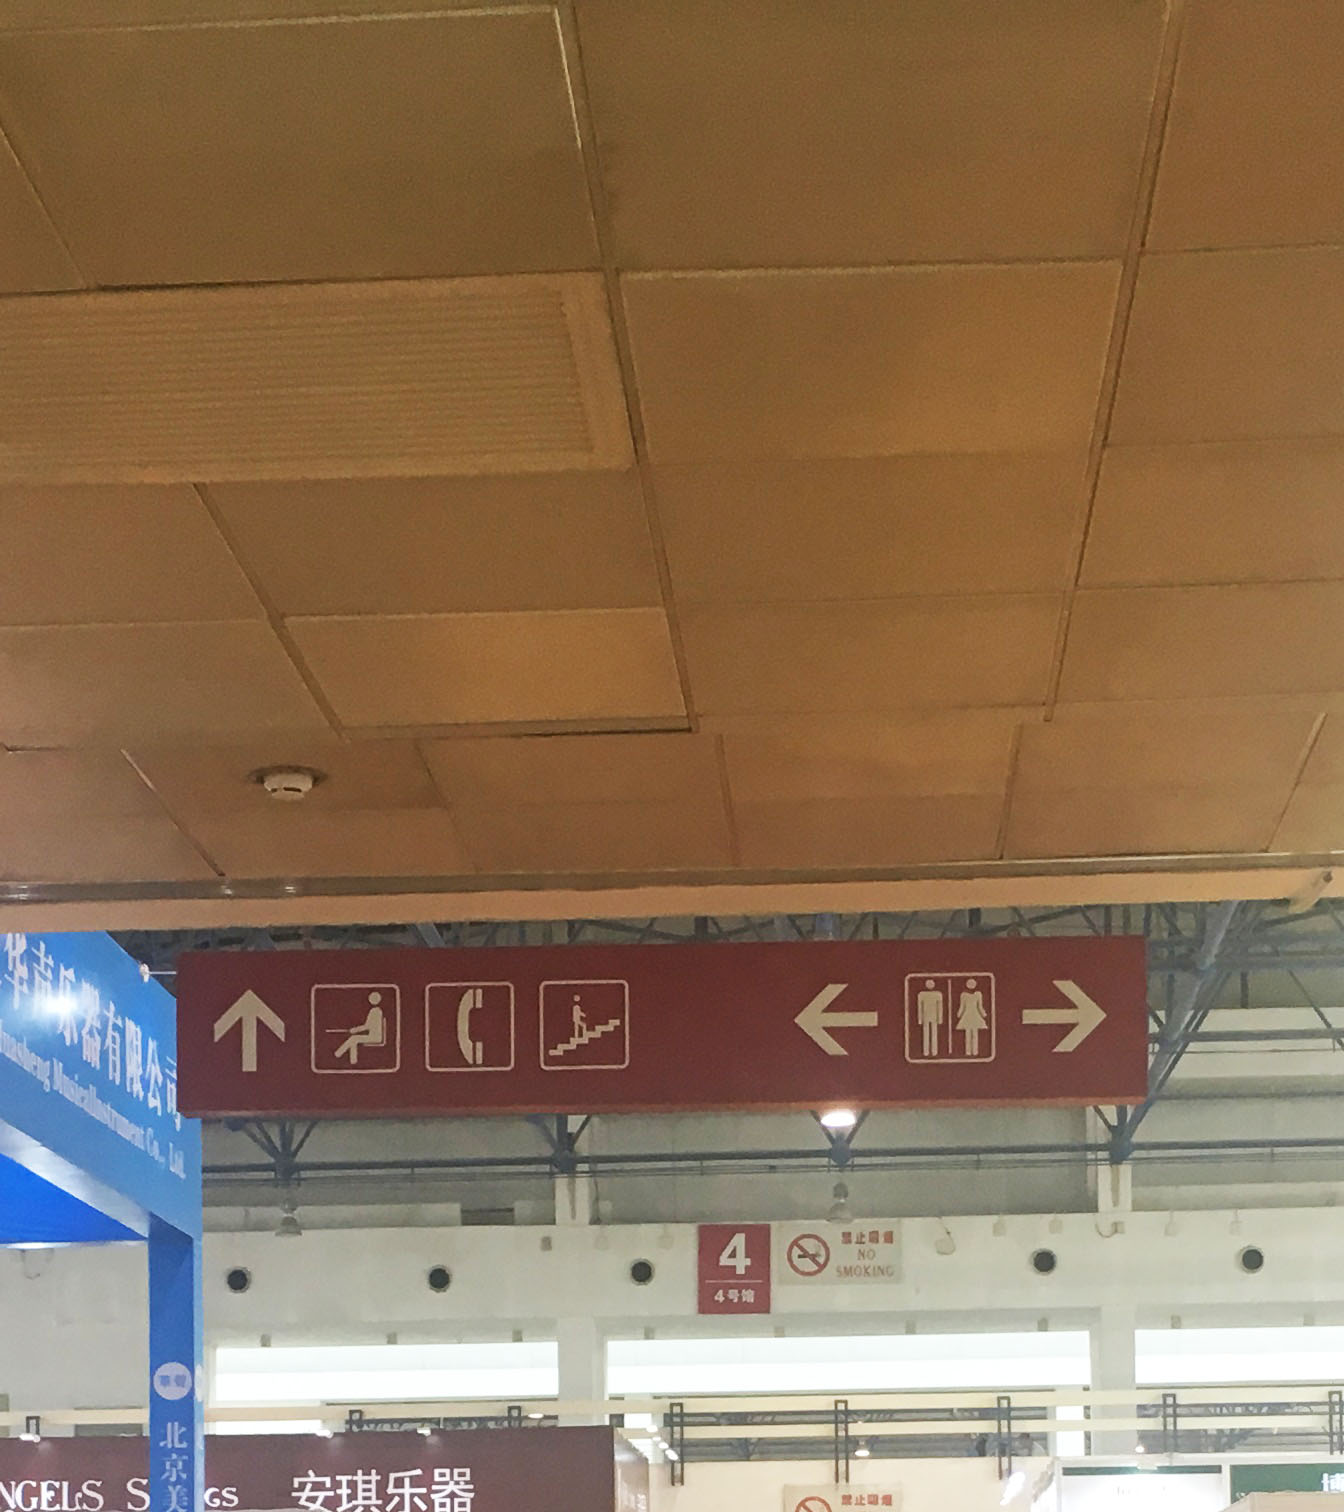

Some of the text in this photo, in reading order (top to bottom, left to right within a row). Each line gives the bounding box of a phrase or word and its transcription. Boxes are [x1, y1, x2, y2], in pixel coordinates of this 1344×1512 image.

[719, 1232, 752, 1275] 4
[857, 1248, 876, 1261] NO
[836, 1264, 895, 1279] SMOKING
[713, 1288, 756, 1304] 4号馆
